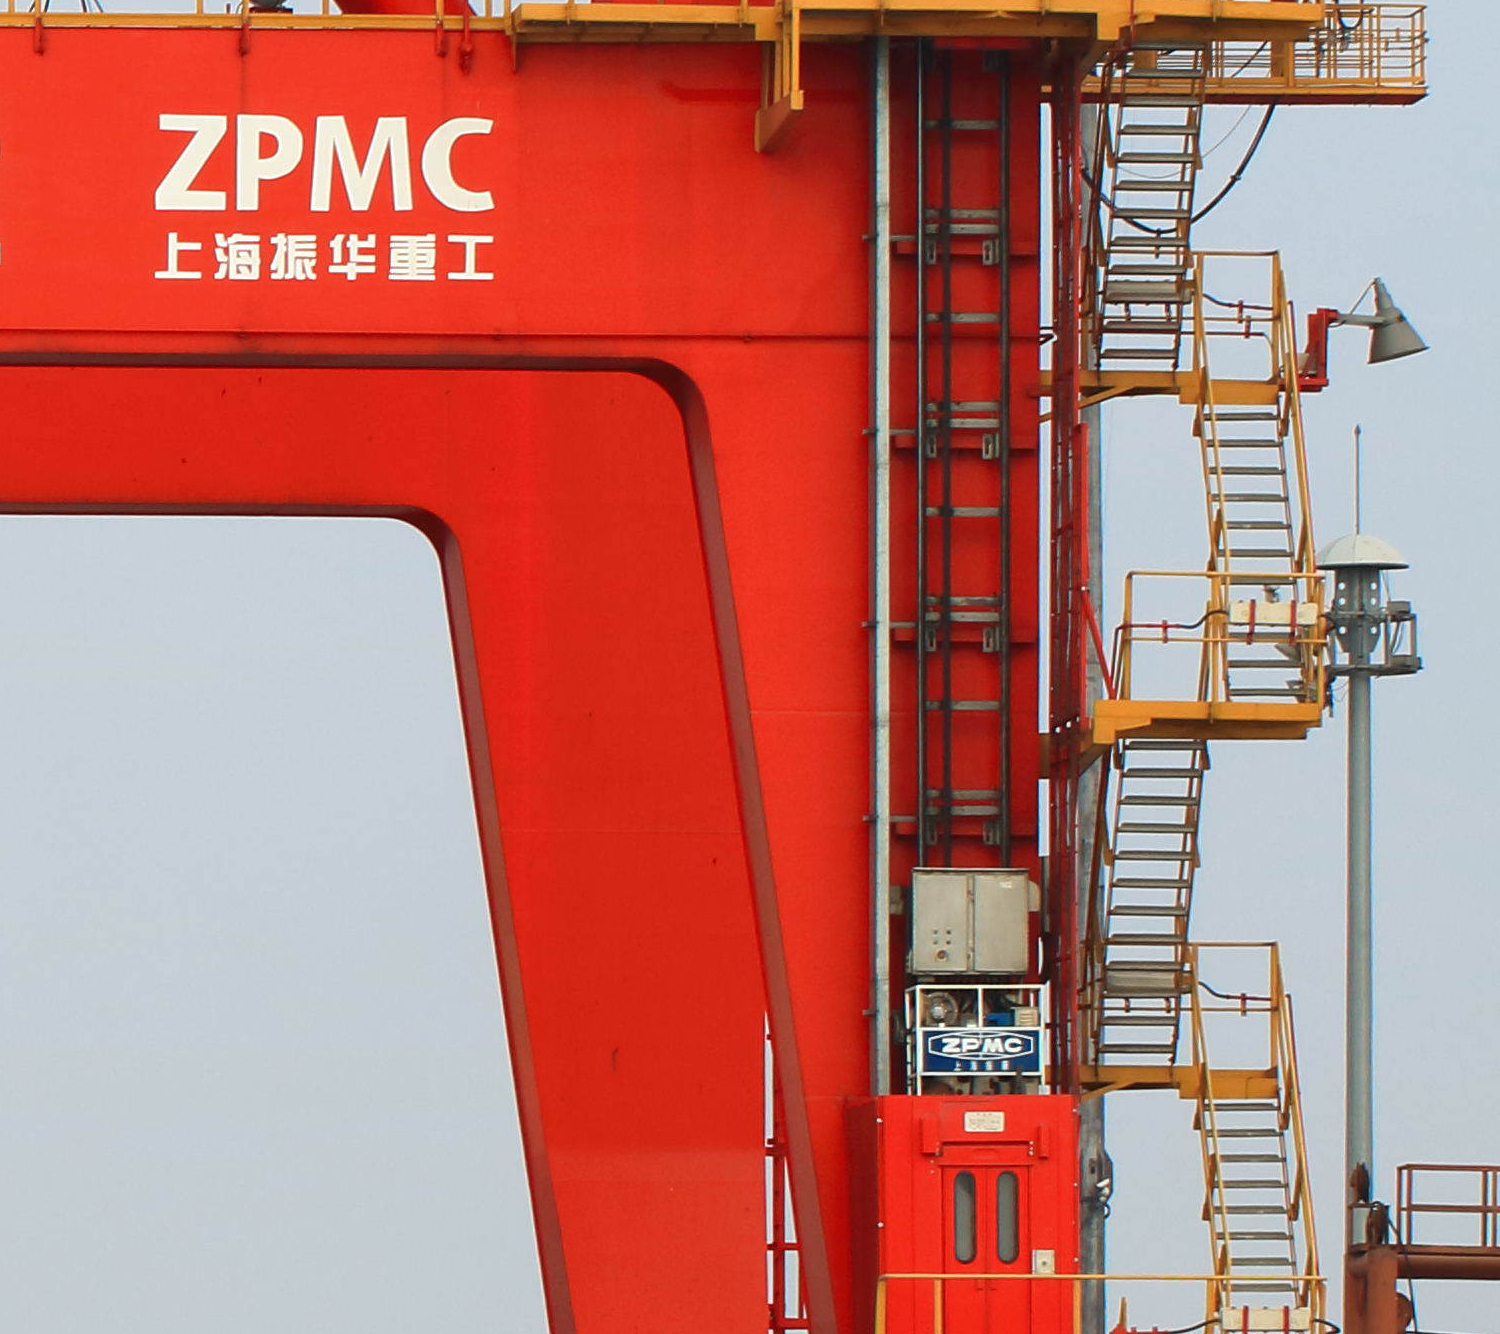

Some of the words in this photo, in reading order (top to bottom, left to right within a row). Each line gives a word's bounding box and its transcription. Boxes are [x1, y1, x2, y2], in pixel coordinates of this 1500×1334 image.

[156, 114, 495, 213] ZPMC
[155, 232, 495, 281] 上海振华重工
[942, 1037, 1022, 1053] ZPMC
